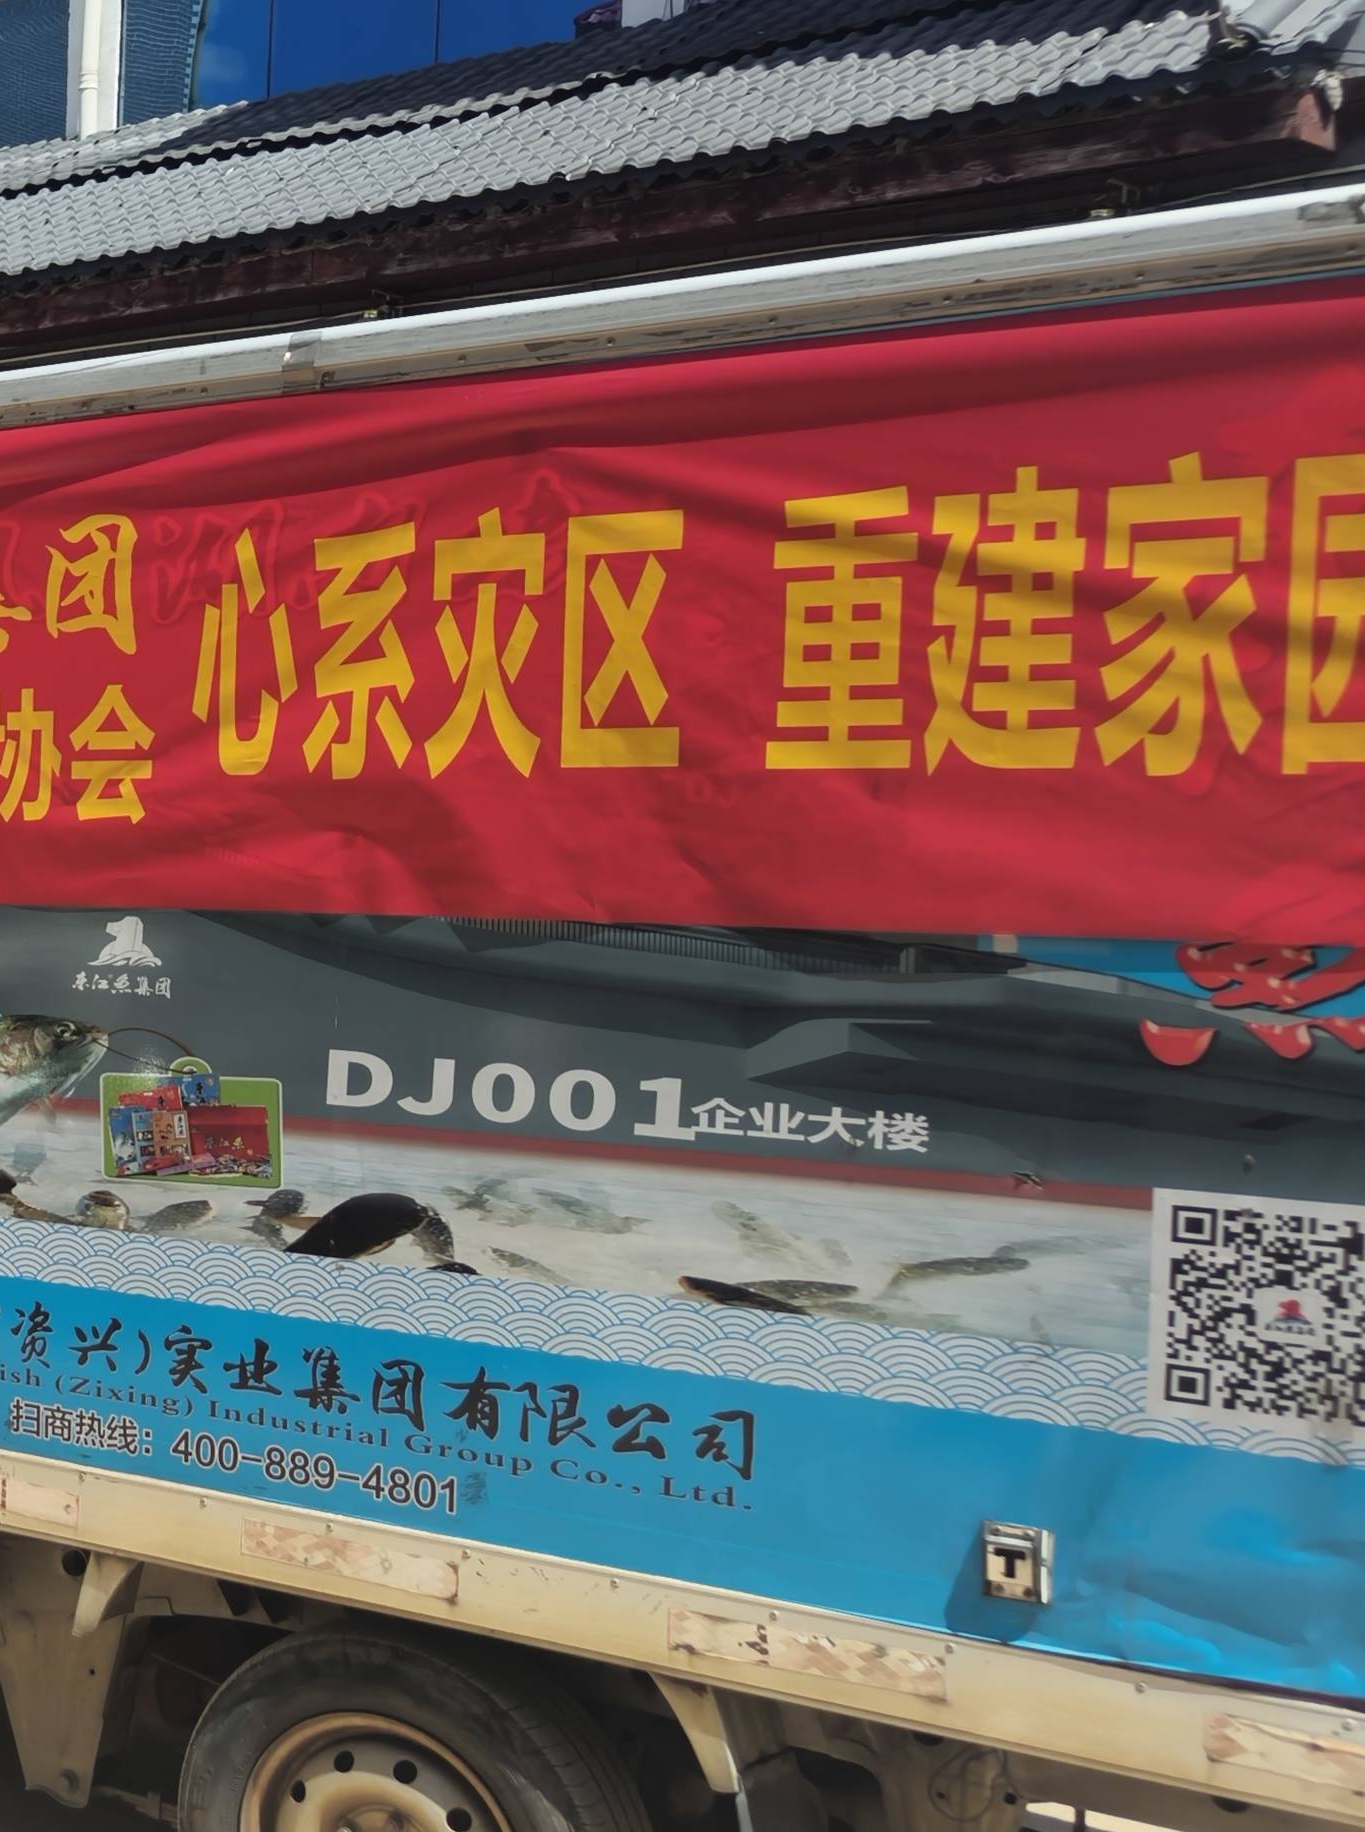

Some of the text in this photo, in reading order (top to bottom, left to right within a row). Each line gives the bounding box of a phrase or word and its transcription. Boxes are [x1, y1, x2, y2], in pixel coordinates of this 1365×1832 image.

[191, 507, 685, 781] 心系灾区
[325, 1048, 930, 1154] DJ001 企业大楼
[54, 1374, 194, 1418] (Zixing)
[208, 1399, 389, 1448] Industrial
[404, 1433, 533, 1476] Group
[659, 1476, 753, 1511] Ltd.
[170, 1428, 458, 1515] 400-889-4801
